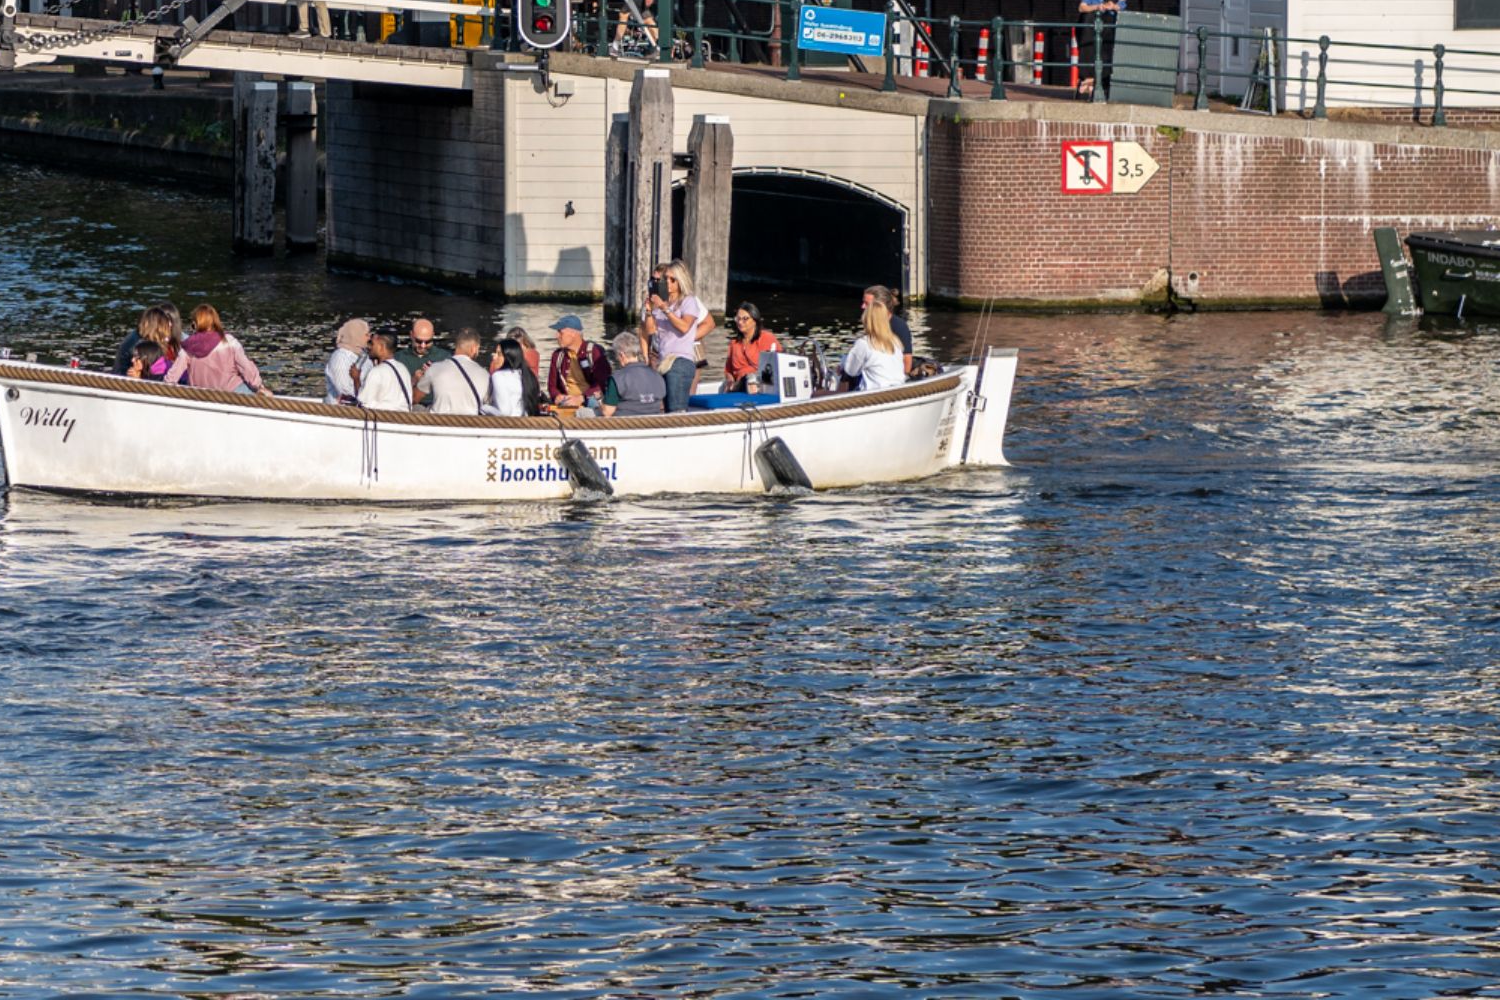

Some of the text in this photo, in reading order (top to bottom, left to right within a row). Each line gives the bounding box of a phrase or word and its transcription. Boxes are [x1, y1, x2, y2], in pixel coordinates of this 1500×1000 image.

[1118, 157, 1144, 178] 3,5
[1427, 252, 1476, 269] INDABO
[20, 406, 76, 444] Willy
[501, 443, 617, 461] amsteam
